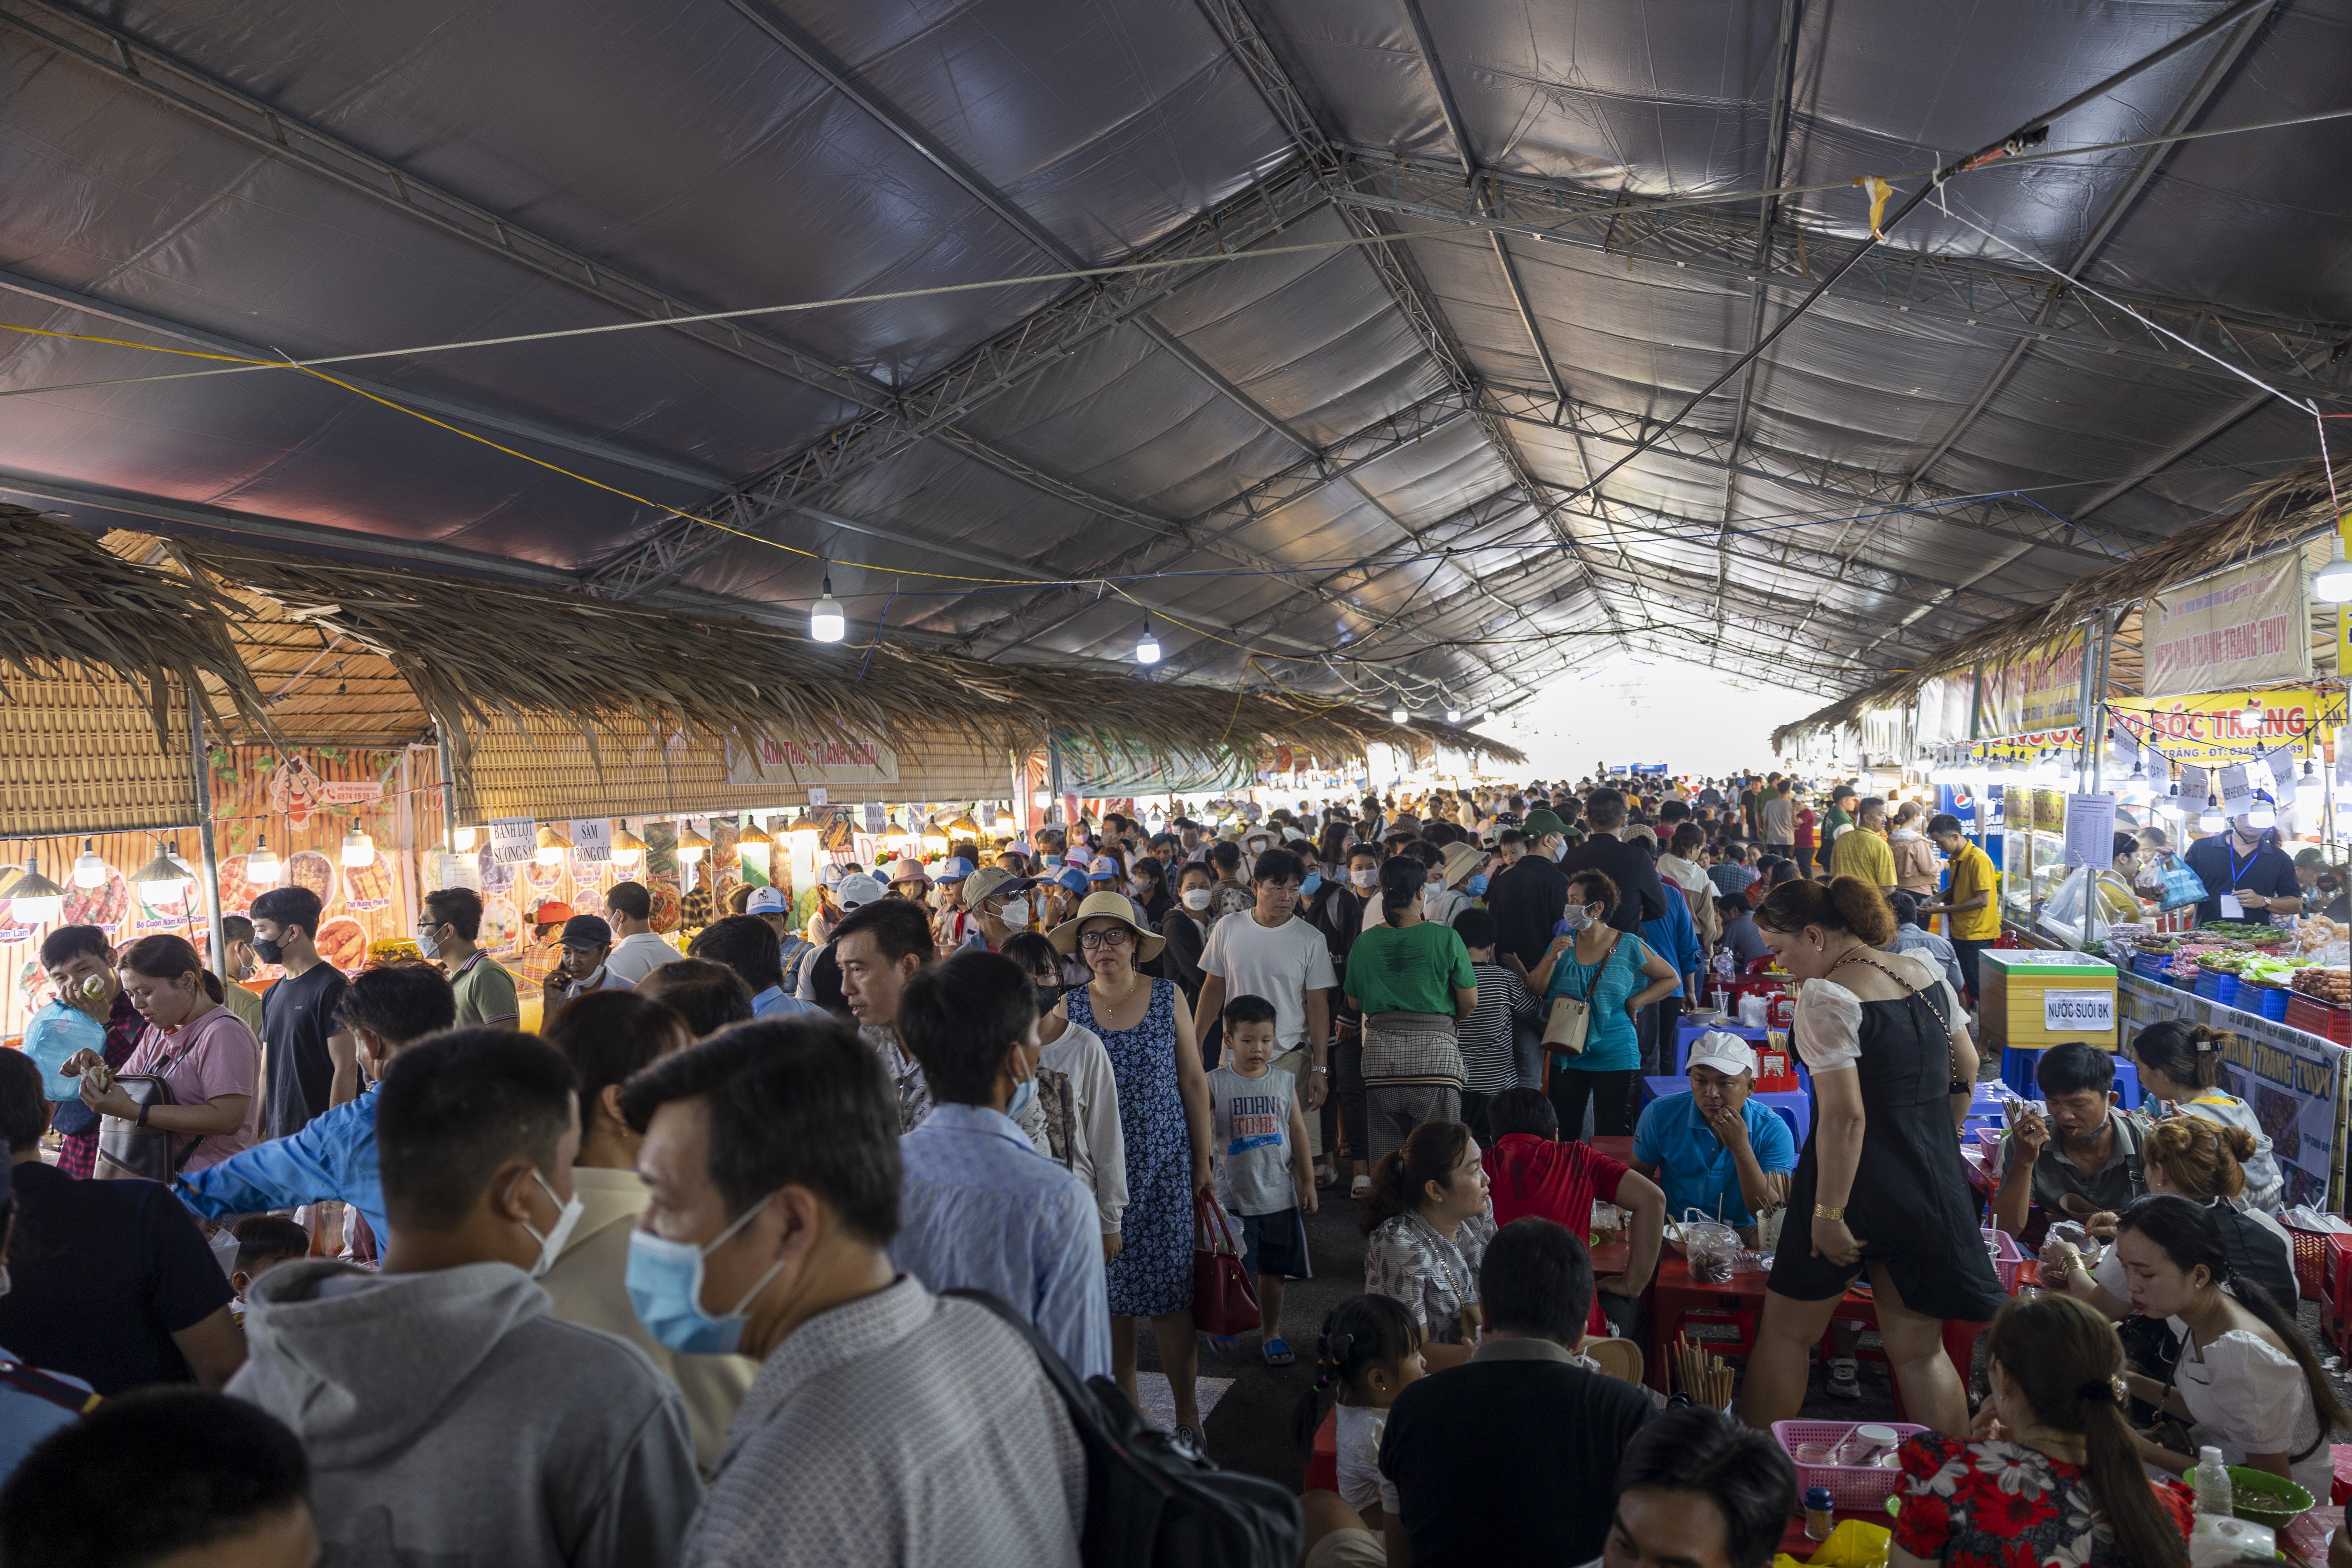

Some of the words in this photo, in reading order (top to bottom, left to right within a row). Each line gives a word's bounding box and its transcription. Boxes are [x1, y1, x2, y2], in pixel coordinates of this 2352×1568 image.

[2175, 627, 2190, 671] CHẢ
[2193, 631, 2222, 666] THANH
[2224, 622, 2257, 661] TRANG
[2260, 604, 2287, 655] THỦY
[2153, 703, 2206, 739] SÓC
[2213, 700, 2305, 738] TRĂNG
[2162, 747, 2199, 758] TRĂNG
[494, 819, 516, 839] BÁNH
[518, 821, 533, 840] LỌT
[582, 821, 598, 839] SÂM
[494, 845, 522, 864] SƯƠNG
[524, 840, 538, 860] SÁO
[576, 843, 596, 861] BÔNG
[597, 842, 612, 861] CÚC
[146, 920, 161, 928] Cuộn
[163, 917, 175, 925] Nấm
[0, 930, 10, 938] ơm
[13, 929, 28, 937] Lam
[2049, 999, 2073, 1018] NƯỚC
[2076, 1000, 2096, 1018] SUỐI
[2098, 1004, 2109, 1018] 8K
[2257, 1044, 2291, 1085] TRANG
[2296, 1059, 2332, 1098] THỦY
[1233, 1096, 1275, 1115] BORN
[1235, 1133, 1278, 1152] Awesome
